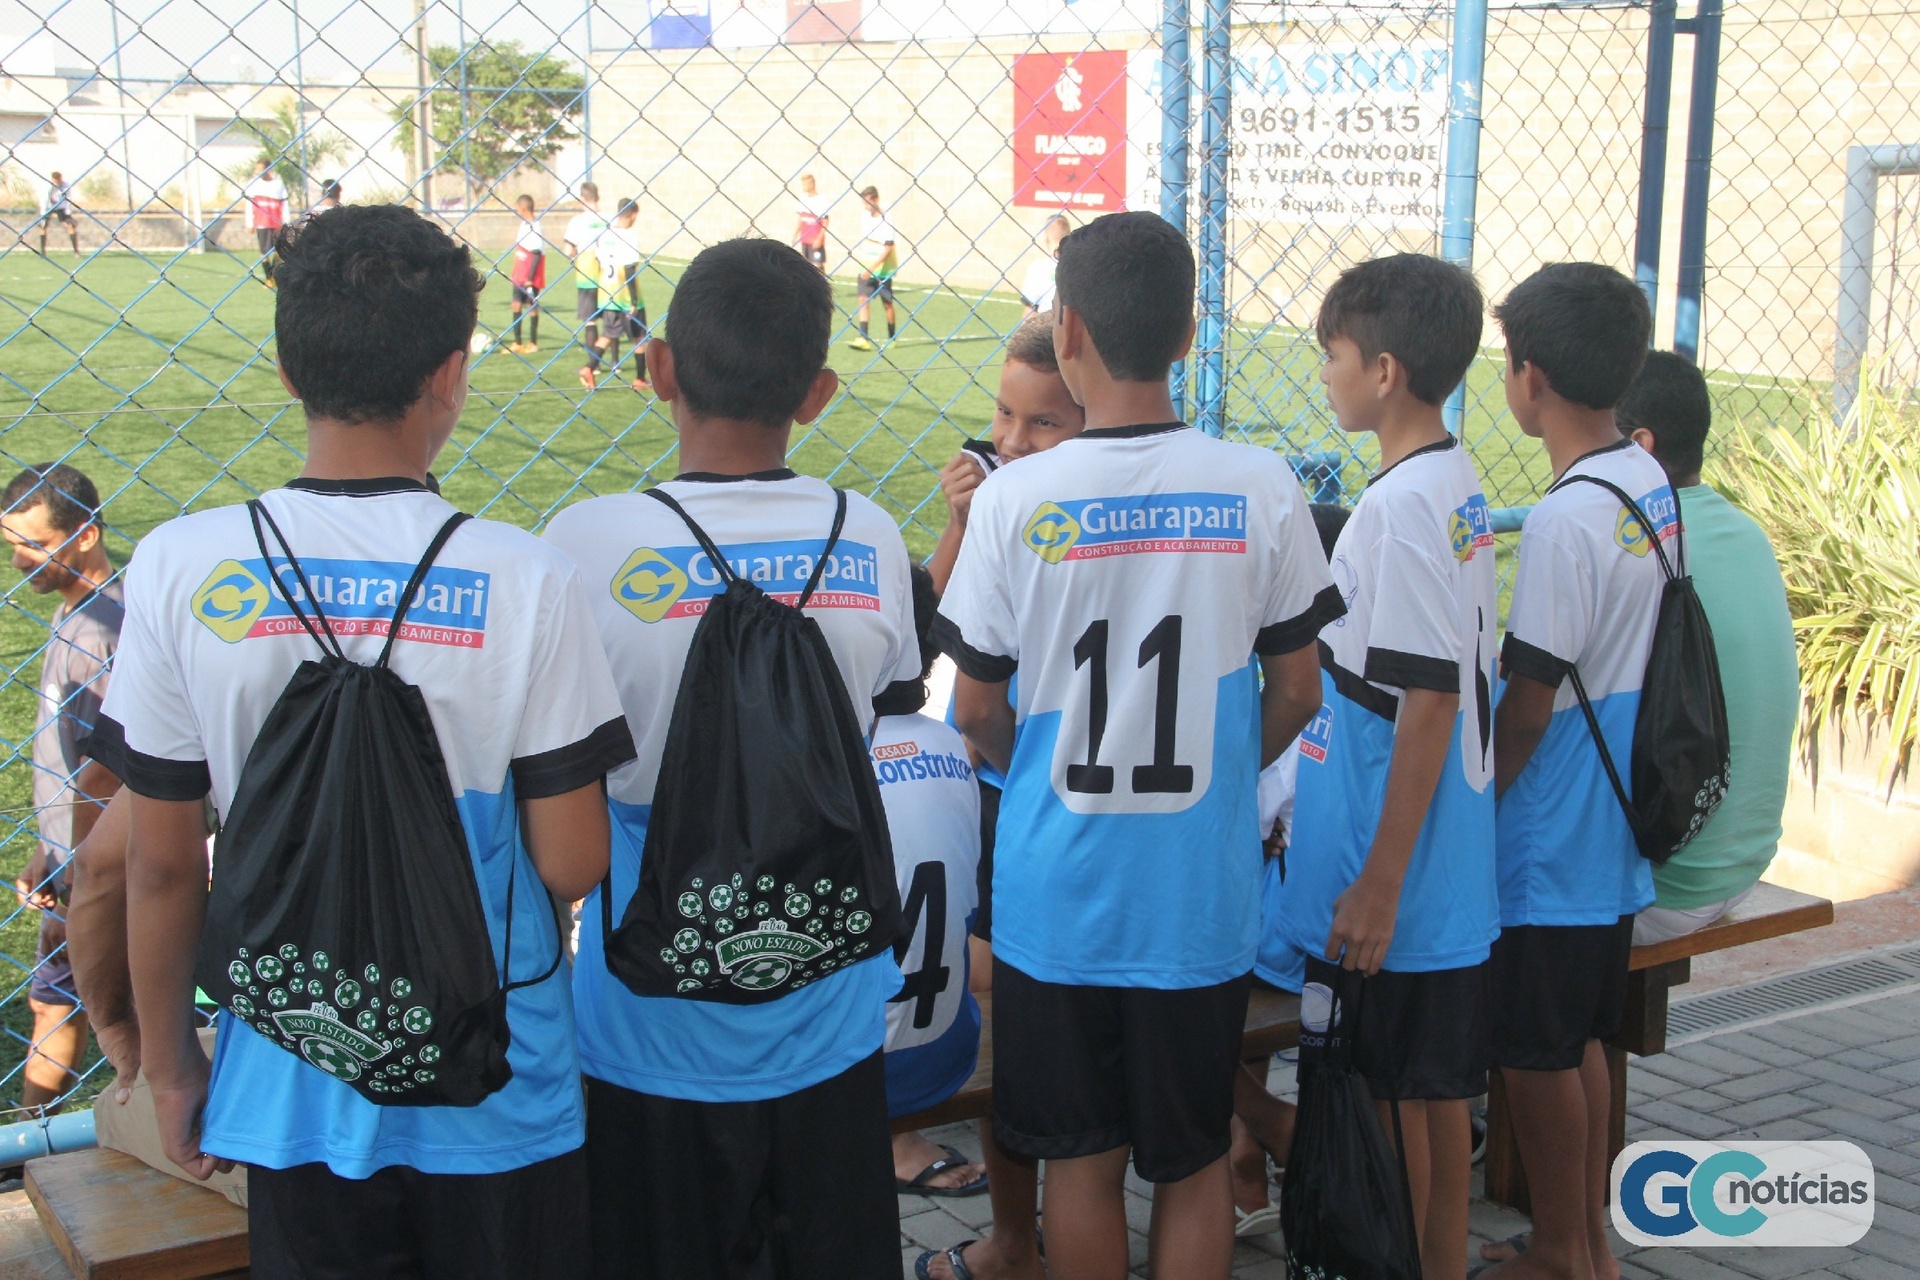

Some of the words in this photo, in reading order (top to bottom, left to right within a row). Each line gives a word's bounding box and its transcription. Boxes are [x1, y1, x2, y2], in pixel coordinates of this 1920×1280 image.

[1146, 54, 1290, 97] ANA
[1241, 105, 1421, 133] 9691-1515
[1035, 134, 1107, 155] FLAMENGO
[1318, 144, 1439, 160] CONVOQUE
[1265, 168, 1336, 185] VENHA
[1342, 171, 1423, 187] CURTIR
[1080, 501, 1244, 538] Guarapari
[1077, 540, 1152, 558] CONSTRUÇÃO
[1154, 541, 1161, 550] E
[1163, 541, 1239, 551] ACABAMENTO
[687, 551, 876, 591] Guarapari
[361, 622, 369, 632] E
[373, 622, 473, 644] ACBAMENTO
[1066, 615, 1194, 794] 11
[874, 745, 900, 759] CASA
[900, 743, 916, 755] DO
[871, 749, 973, 786] onstruto
[731, 938, 762, 955] NOVO
[765, 937, 811, 954] ESTADO
[286, 1018, 316, 1030] NOVO
[319, 1022, 366, 1052] ESTADO
